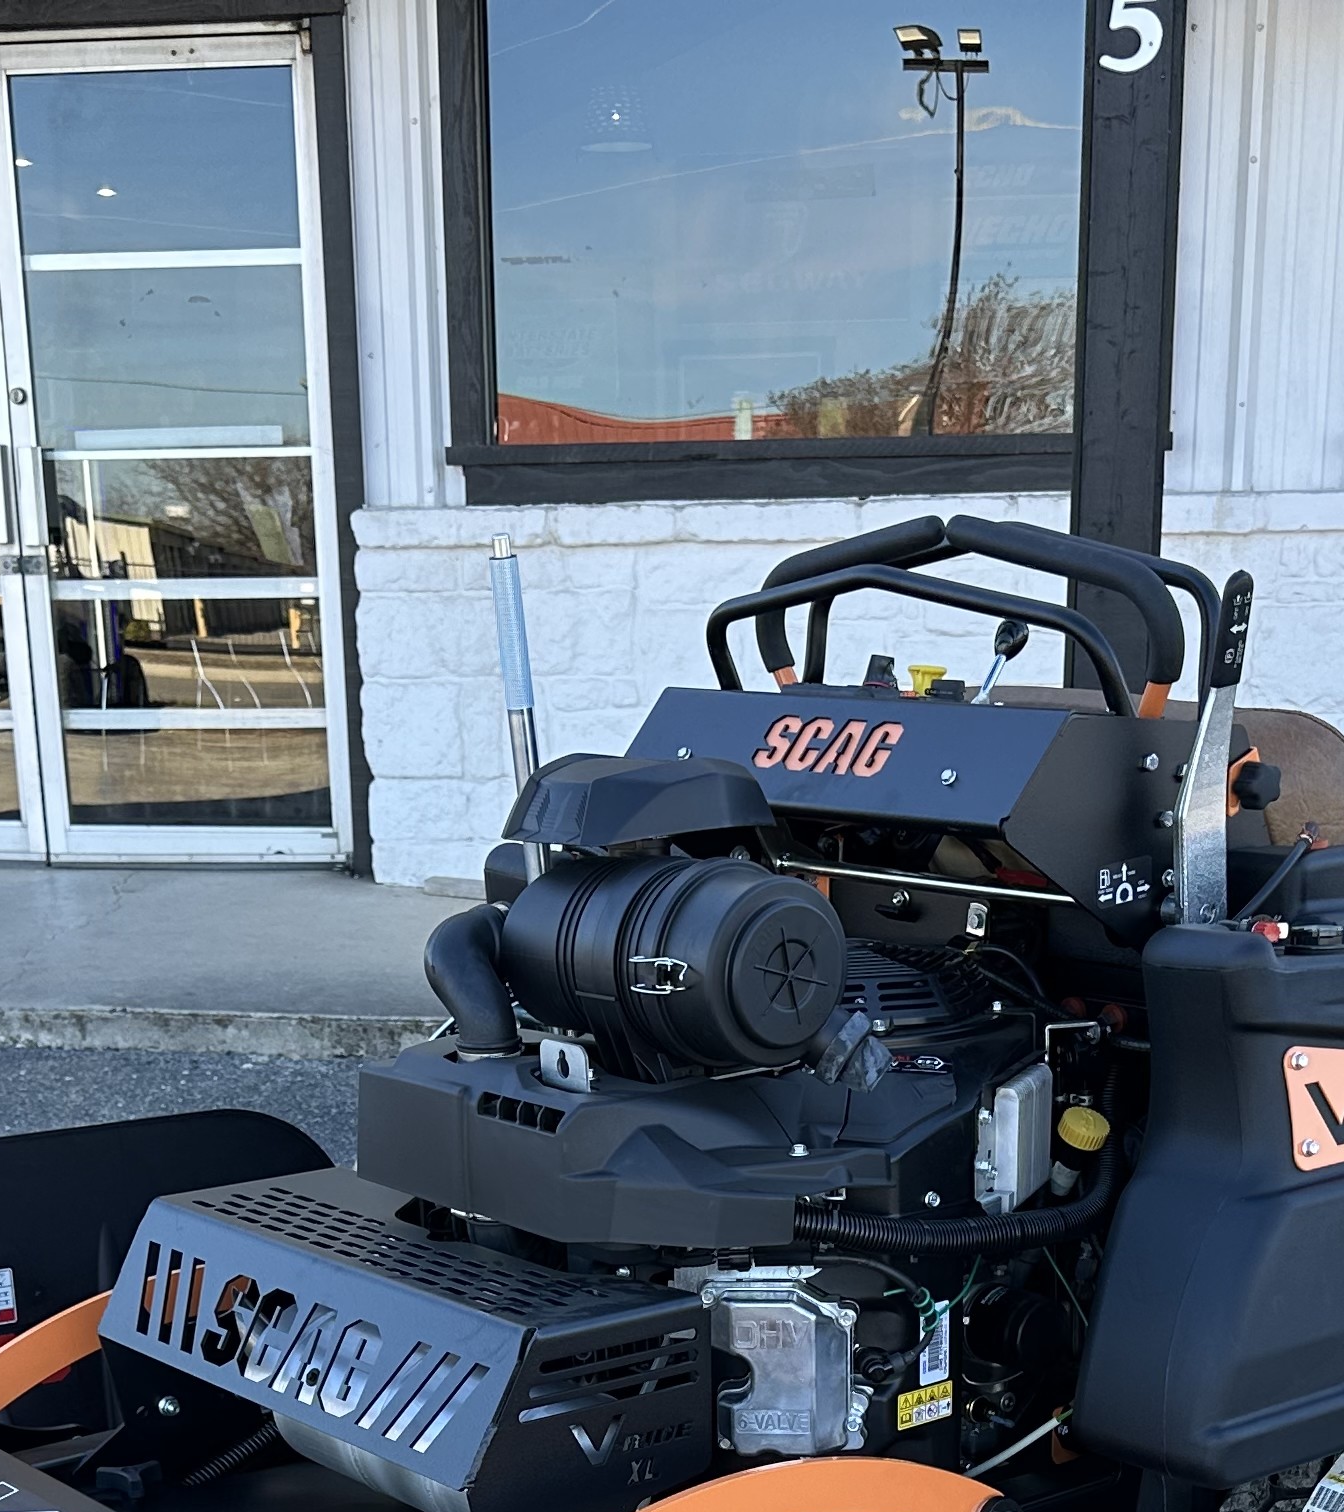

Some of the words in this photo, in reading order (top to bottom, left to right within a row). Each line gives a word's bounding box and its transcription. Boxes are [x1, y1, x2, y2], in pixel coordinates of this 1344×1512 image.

[1099, 0, 1164, 73] 5
[752, 715, 905, 778] SCAG
[201, 1275, 384, 1418] SCAG
[739, 1411, 809, 1431] 6-VALVE
[627, 1458, 658, 1486] XL
